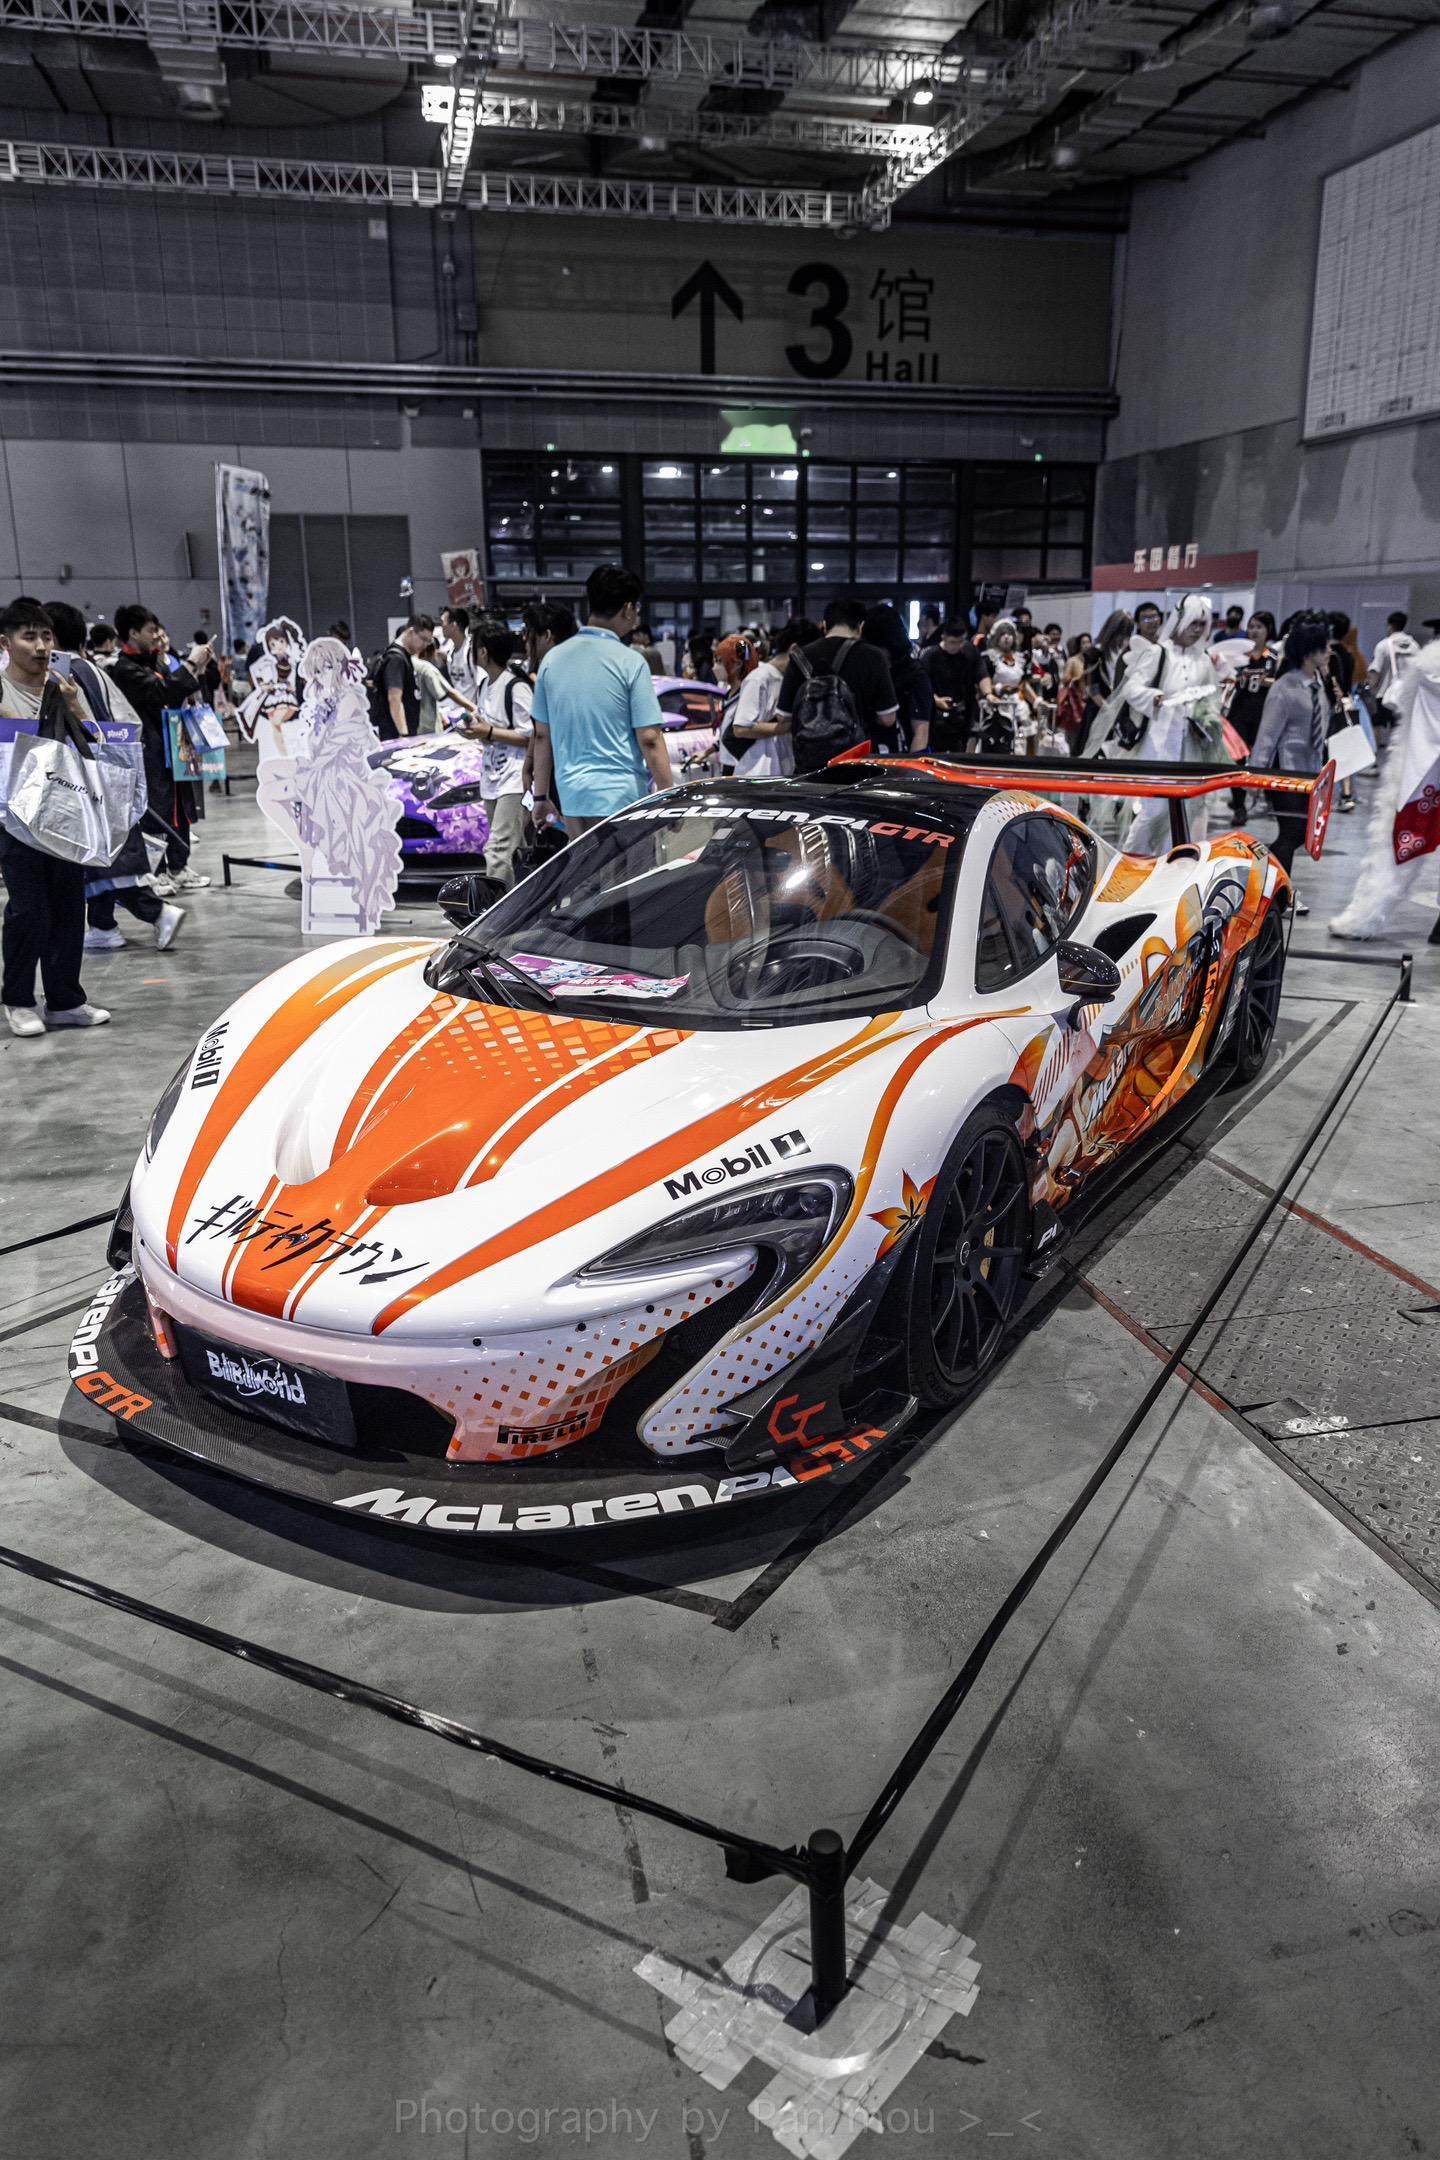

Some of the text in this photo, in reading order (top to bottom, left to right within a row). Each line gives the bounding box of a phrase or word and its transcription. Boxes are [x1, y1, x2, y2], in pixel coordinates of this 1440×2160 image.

[785, 262, 935, 380] 3 馆
[866, 351, 939, 383] Hall
[611, 806, 956, 848] McLaren P1 GTR
[192, 1021, 230, 1088] Mobil 1
[663, 1131, 811, 1200] Mobil 1
[75, 1370, 153, 1421] GTR
[496, 1411, 589, 1444] PIRELLI
[333, 1484, 714, 1531] McLaren
